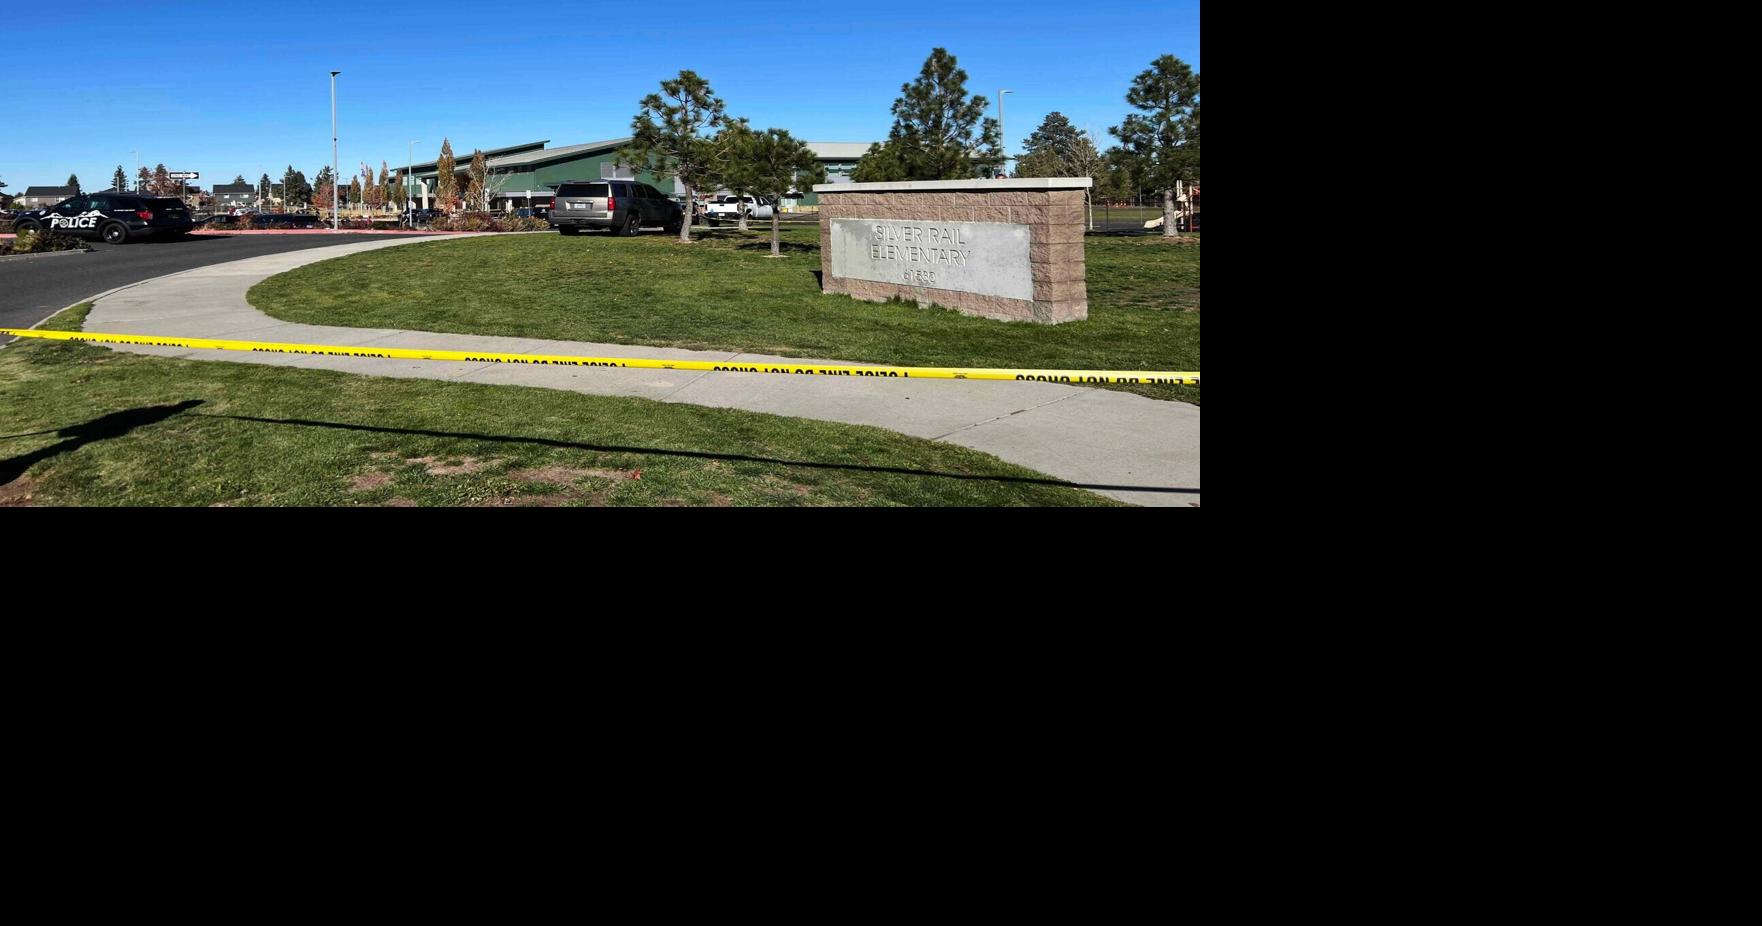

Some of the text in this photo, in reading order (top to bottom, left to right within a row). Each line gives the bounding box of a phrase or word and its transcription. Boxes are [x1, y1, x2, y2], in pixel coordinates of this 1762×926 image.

[50, 217, 97, 228] POLICE
[874, 225, 966, 245] SILVER RAIL
[871, 244, 971, 267] ELEMENTARY
